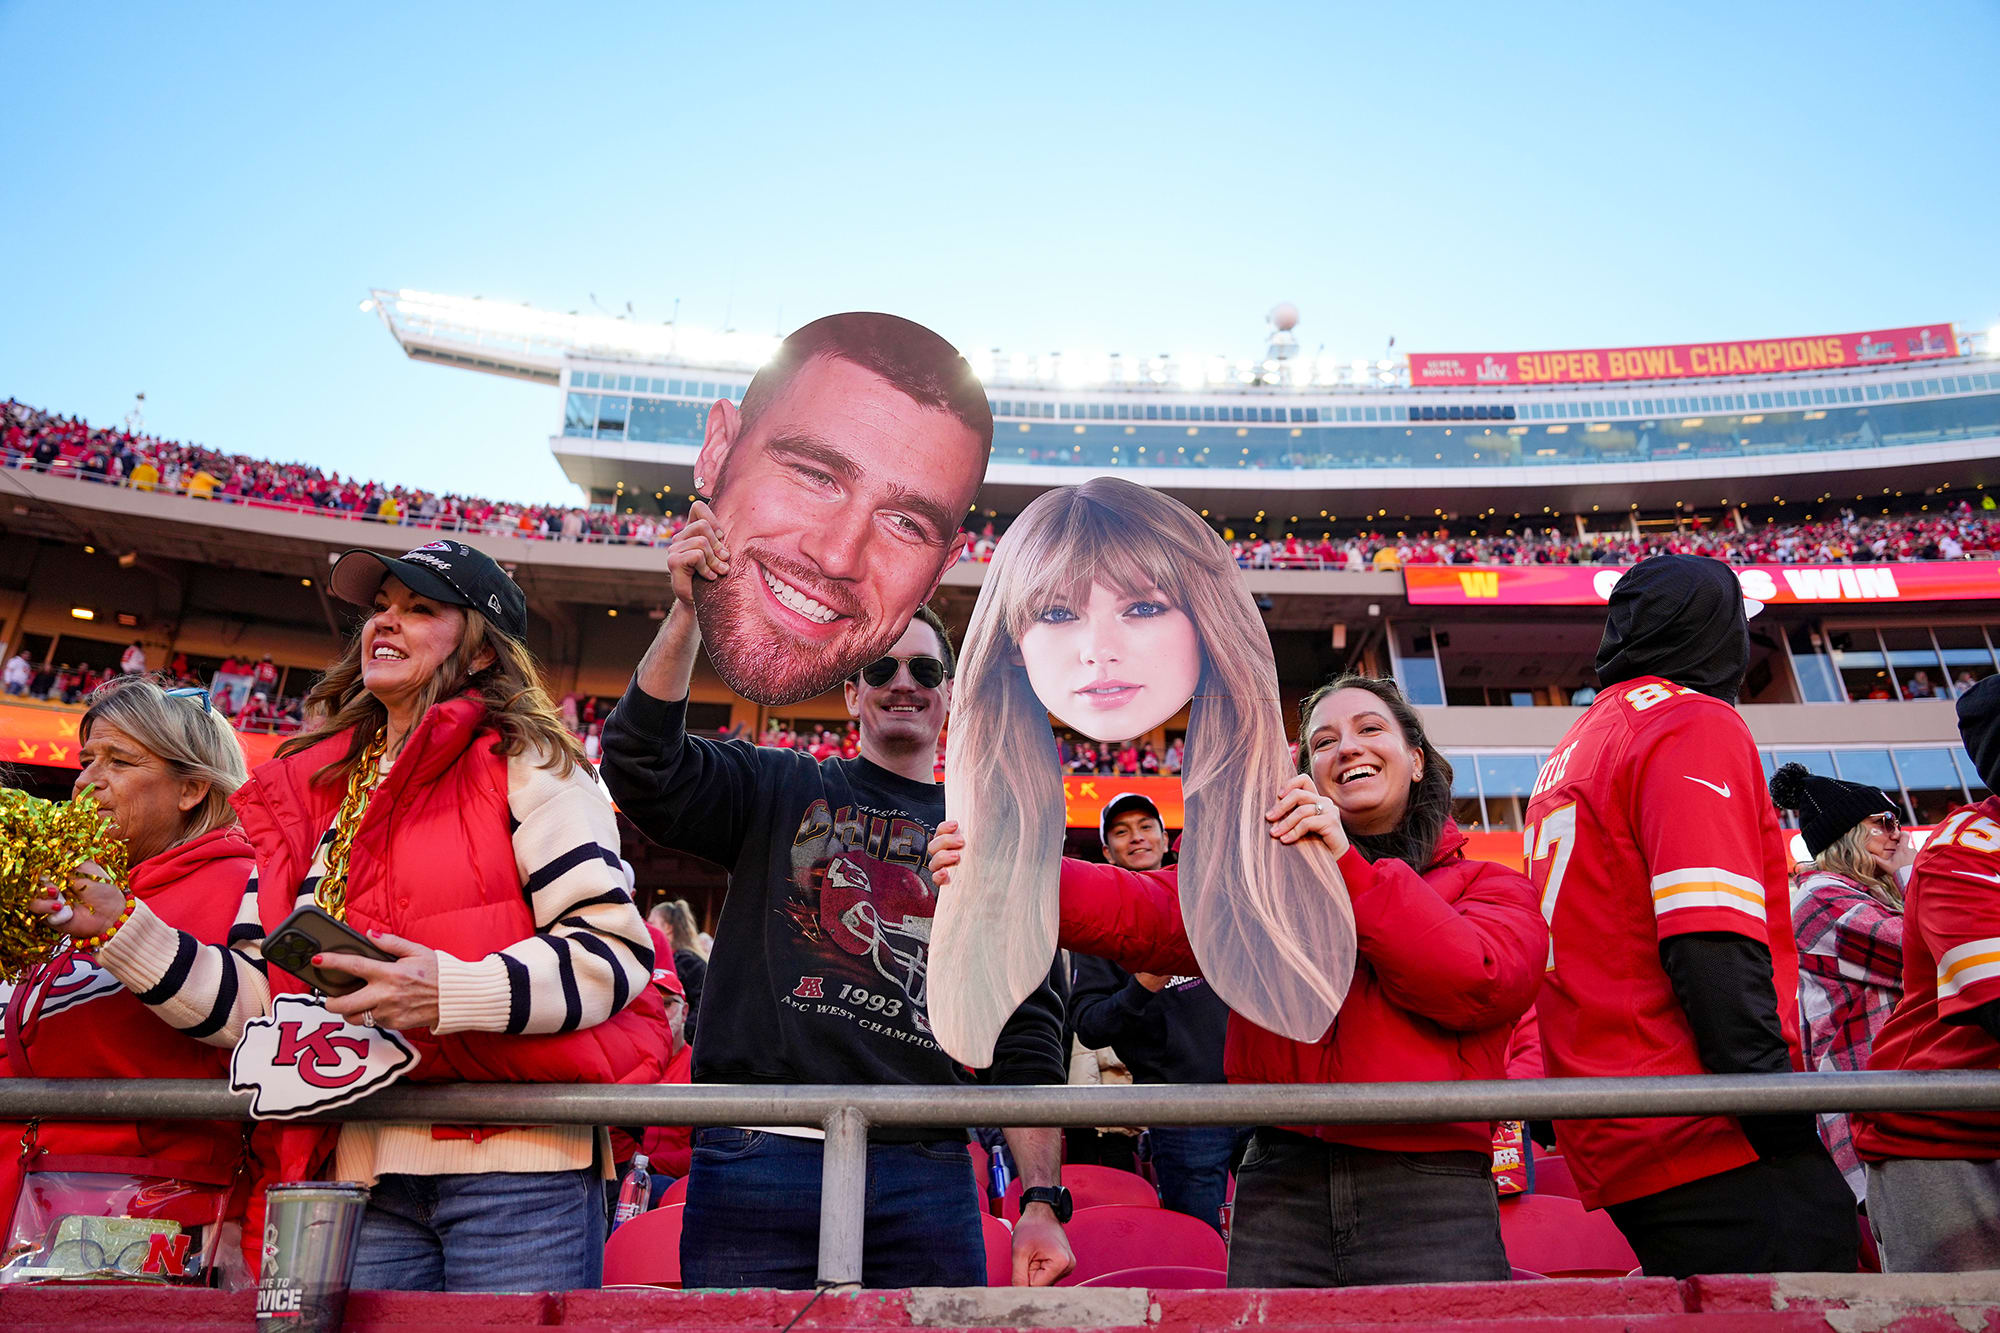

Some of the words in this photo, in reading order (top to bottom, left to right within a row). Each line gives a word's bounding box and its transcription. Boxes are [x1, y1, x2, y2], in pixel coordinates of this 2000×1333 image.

[1517, 353, 1601, 382] SUPER
[1608, 349, 1684, 377] BOWL
[1690, 338, 1846, 374] CHAMPIONS
[1782, 567, 1899, 599] WIN
[793, 799, 934, 867] CHIE
[1926, 811, 2000, 854] 15
[780, 995, 810, 1012] AFC
[816, 1003, 857, 1021] WEST
[838, 983, 904, 1018] 1993
[272, 1021, 370, 1089] KC
[142, 1233, 191, 1276] N
[277, 1277, 290, 1288] TO
